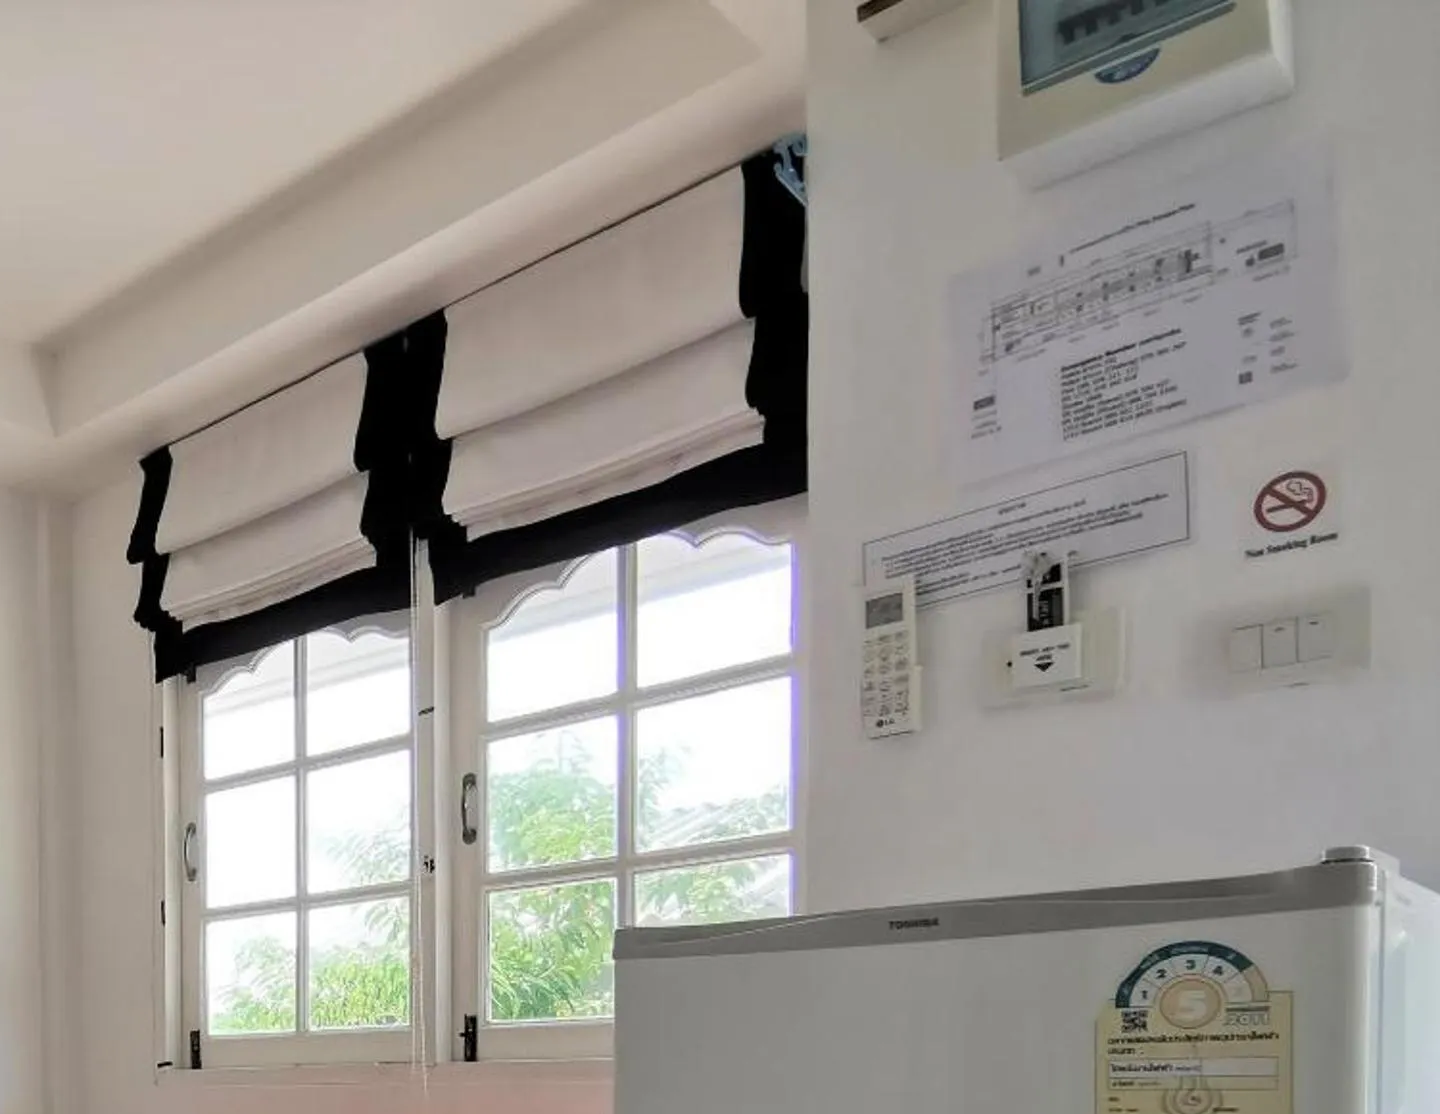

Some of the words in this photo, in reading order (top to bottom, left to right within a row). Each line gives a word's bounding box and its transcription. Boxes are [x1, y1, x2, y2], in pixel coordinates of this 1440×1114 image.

[1156, 969, 1167, 979] 2
[1185, 959, 1196, 970] 3
[1213, 965, 1223, 976] 4
